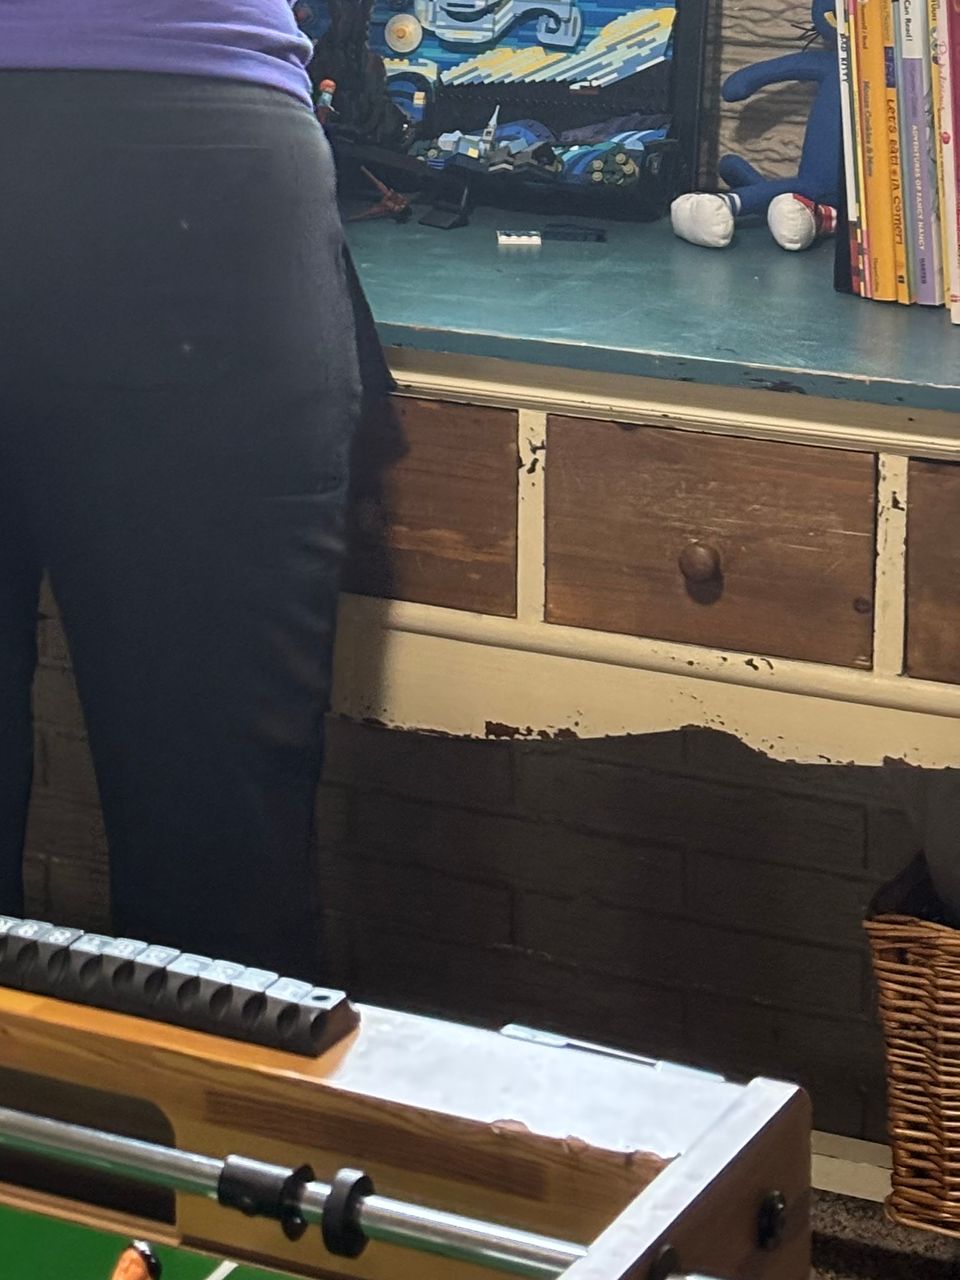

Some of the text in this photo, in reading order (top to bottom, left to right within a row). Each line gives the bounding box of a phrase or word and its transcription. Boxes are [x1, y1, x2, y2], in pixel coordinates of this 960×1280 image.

[903, 0, 911, 15] Can
[905, 18, 913, 42] Read!
[911, 125, 921, 178] ADVENTURES
[915, 179, 922, 191] OF
[916, 192, 924, 220] FANCY
[917, 221, 926, 251] NANCY
